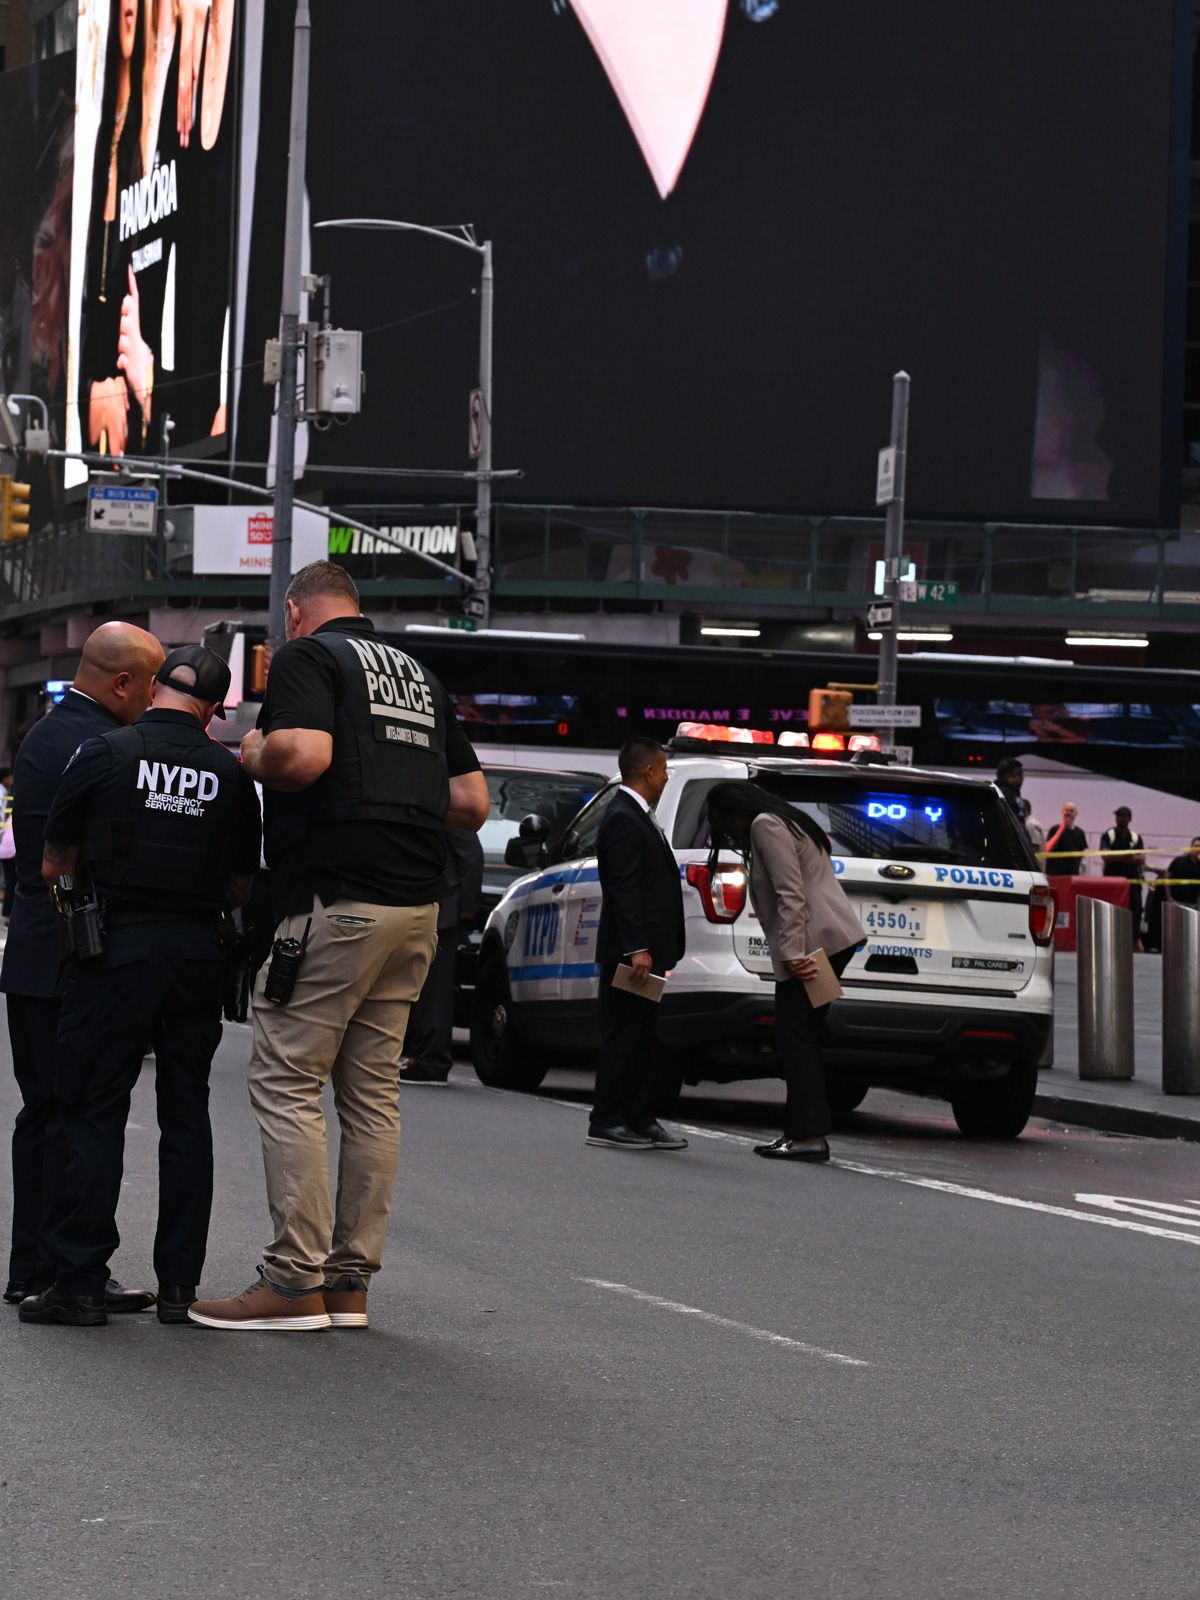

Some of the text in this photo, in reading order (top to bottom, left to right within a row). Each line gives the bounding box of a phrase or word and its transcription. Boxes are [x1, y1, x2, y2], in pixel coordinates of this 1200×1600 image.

[120, 159, 177, 242] PANDORA
[107, 489, 152, 500] BUS LANE
[240, 558, 273, 568] MINIS
[930, 584, 946, 601] 42
[346, 638, 425, 683] NYPD
[365, 670, 435, 716] POLICE
[136, 759, 219, 802] NYPD
[144, 799, 205, 817] SERVICE UNIT
[148, 791, 203, 808] EMERGENCY
[867, 802, 907, 819] DO
[934, 866, 1015, 889] POLICE
[523, 902, 561, 957] NYPD
[866, 911, 920, 931] 4550 18
[867, 943, 933, 959] @NYPDMTS
